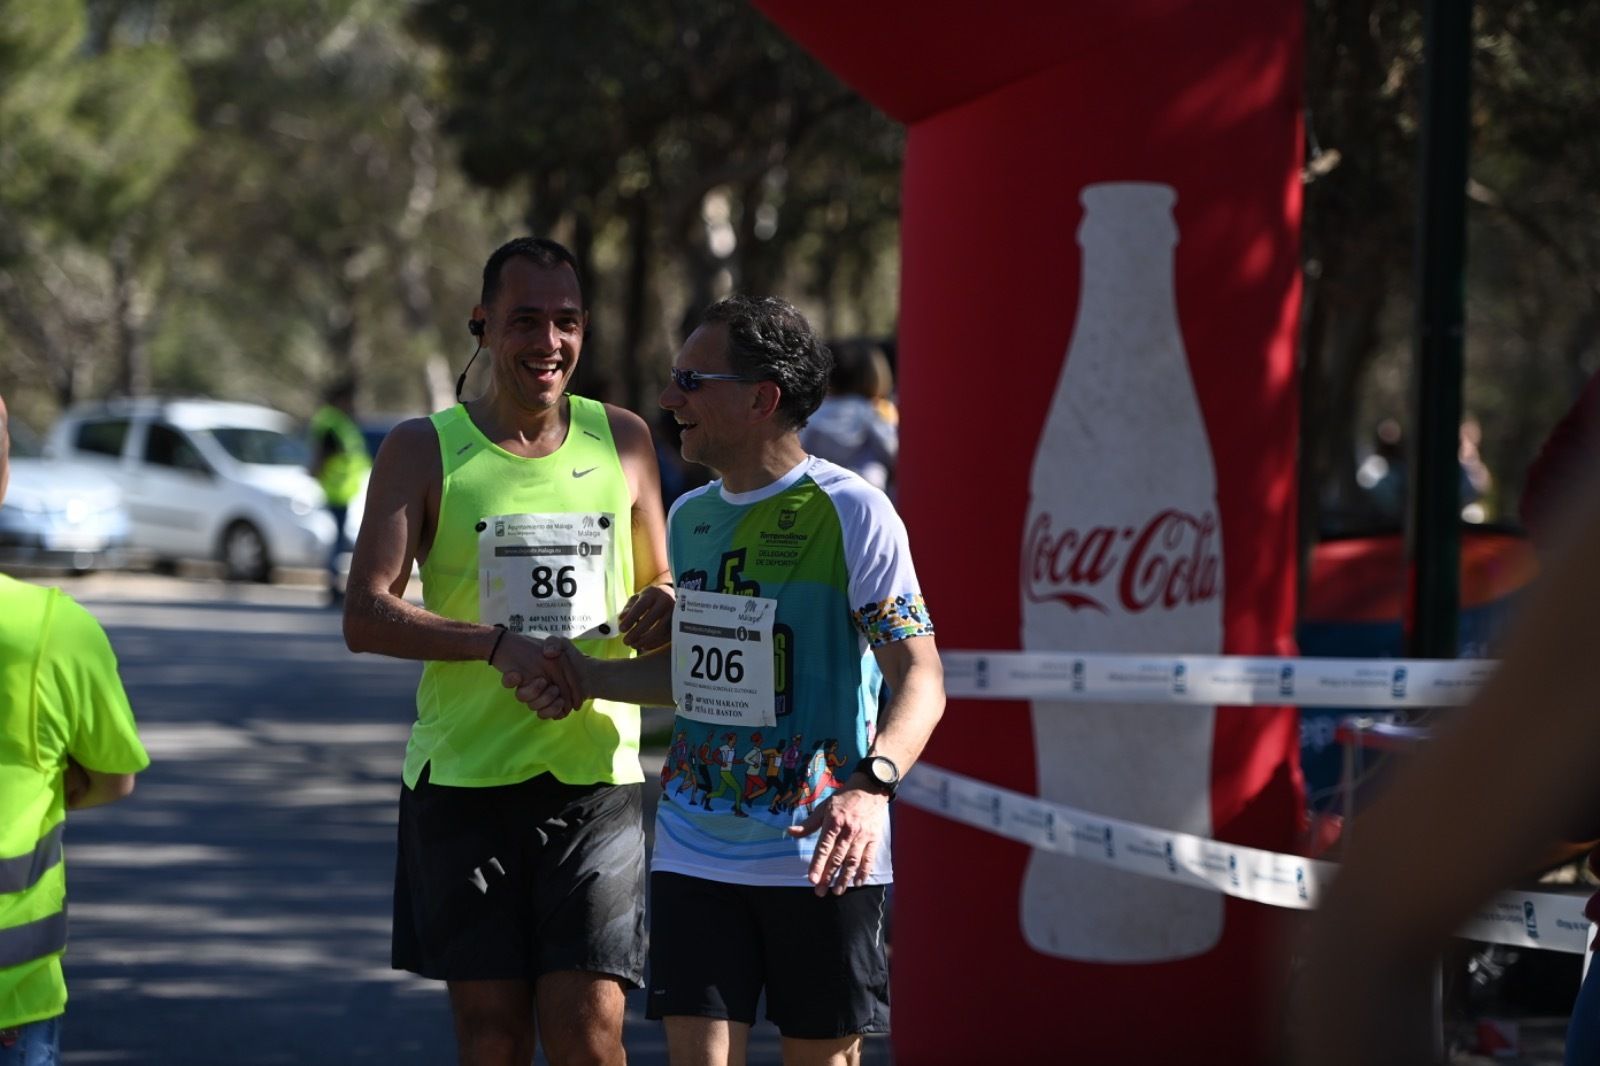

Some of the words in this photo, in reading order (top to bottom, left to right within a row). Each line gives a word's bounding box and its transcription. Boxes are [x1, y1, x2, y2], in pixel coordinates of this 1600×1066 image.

[1023, 507, 1221, 615] Coca-Cola
[531, 566, 578, 599] 86
[540, 615, 559, 623] MINI
[690, 645, 744, 684] 206
